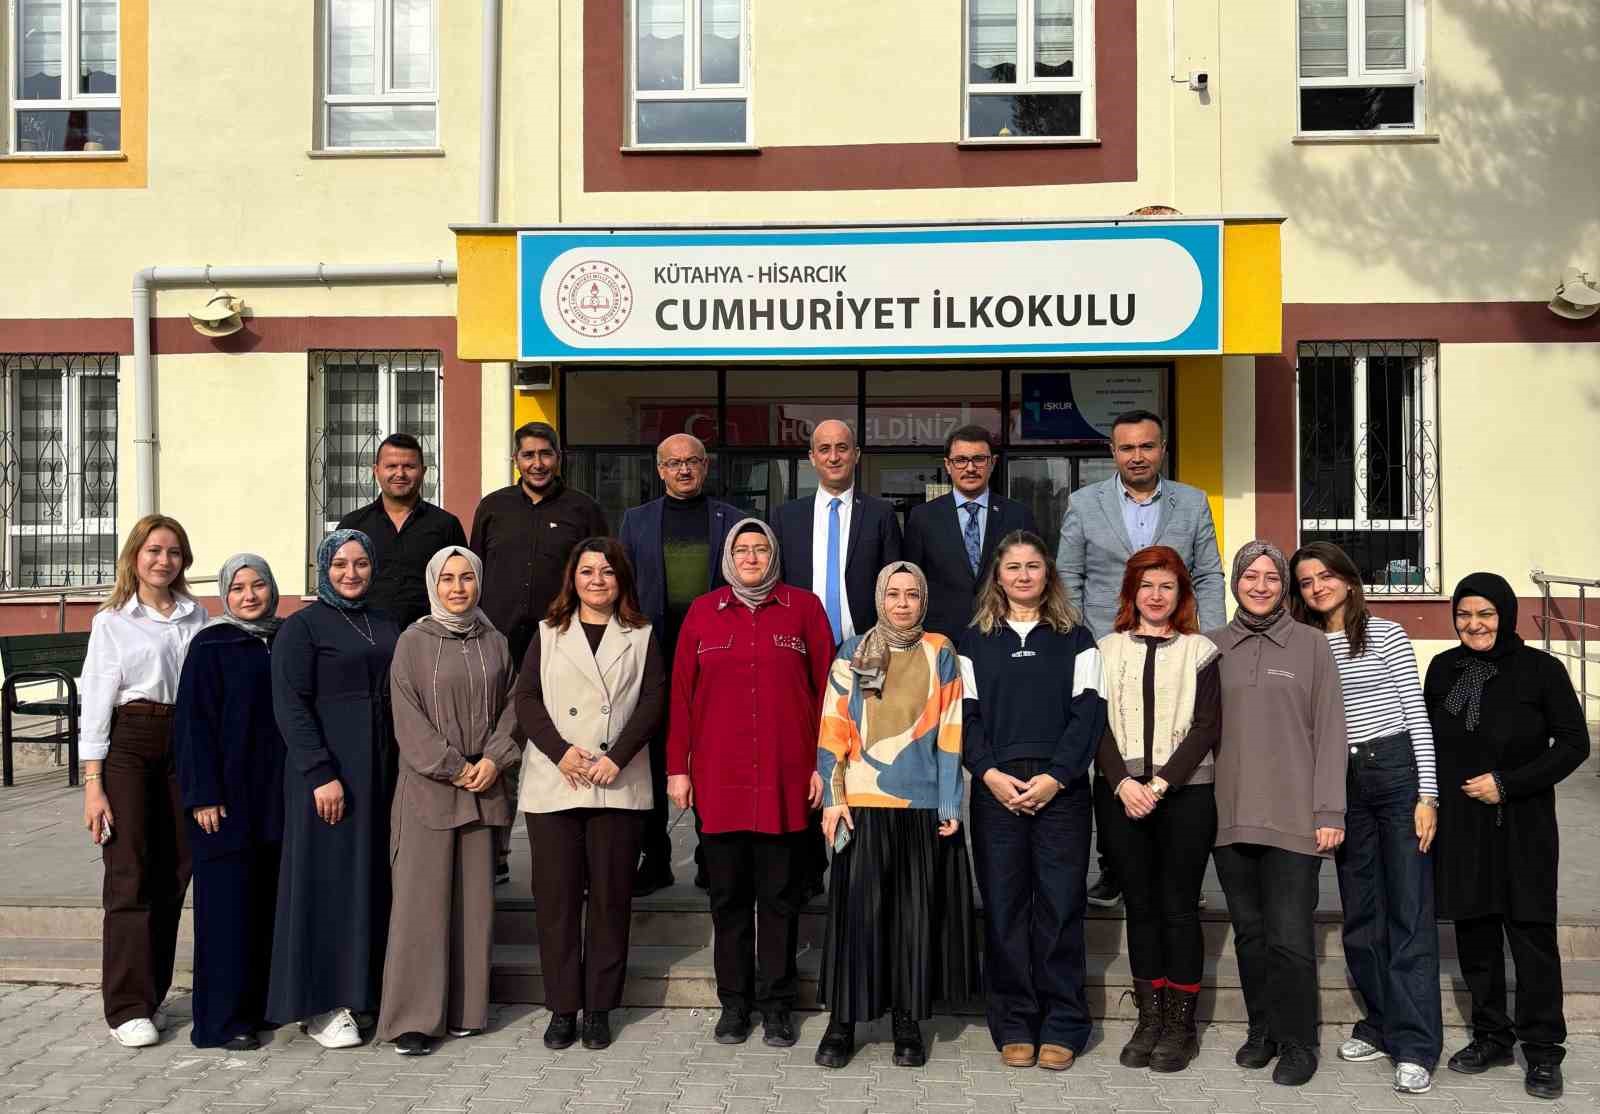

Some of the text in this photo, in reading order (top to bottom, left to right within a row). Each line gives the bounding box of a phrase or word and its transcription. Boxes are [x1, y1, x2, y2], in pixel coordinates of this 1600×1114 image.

[654, 263, 743, 283] KÜTAHYA
[758, 262, 847, 283] HİSARCIK
[655, 290, 920, 331] CUMHURİYET
[933, 289, 1136, 329] İLKOKULU
[855, 413, 958, 441] ELDİNİZ
